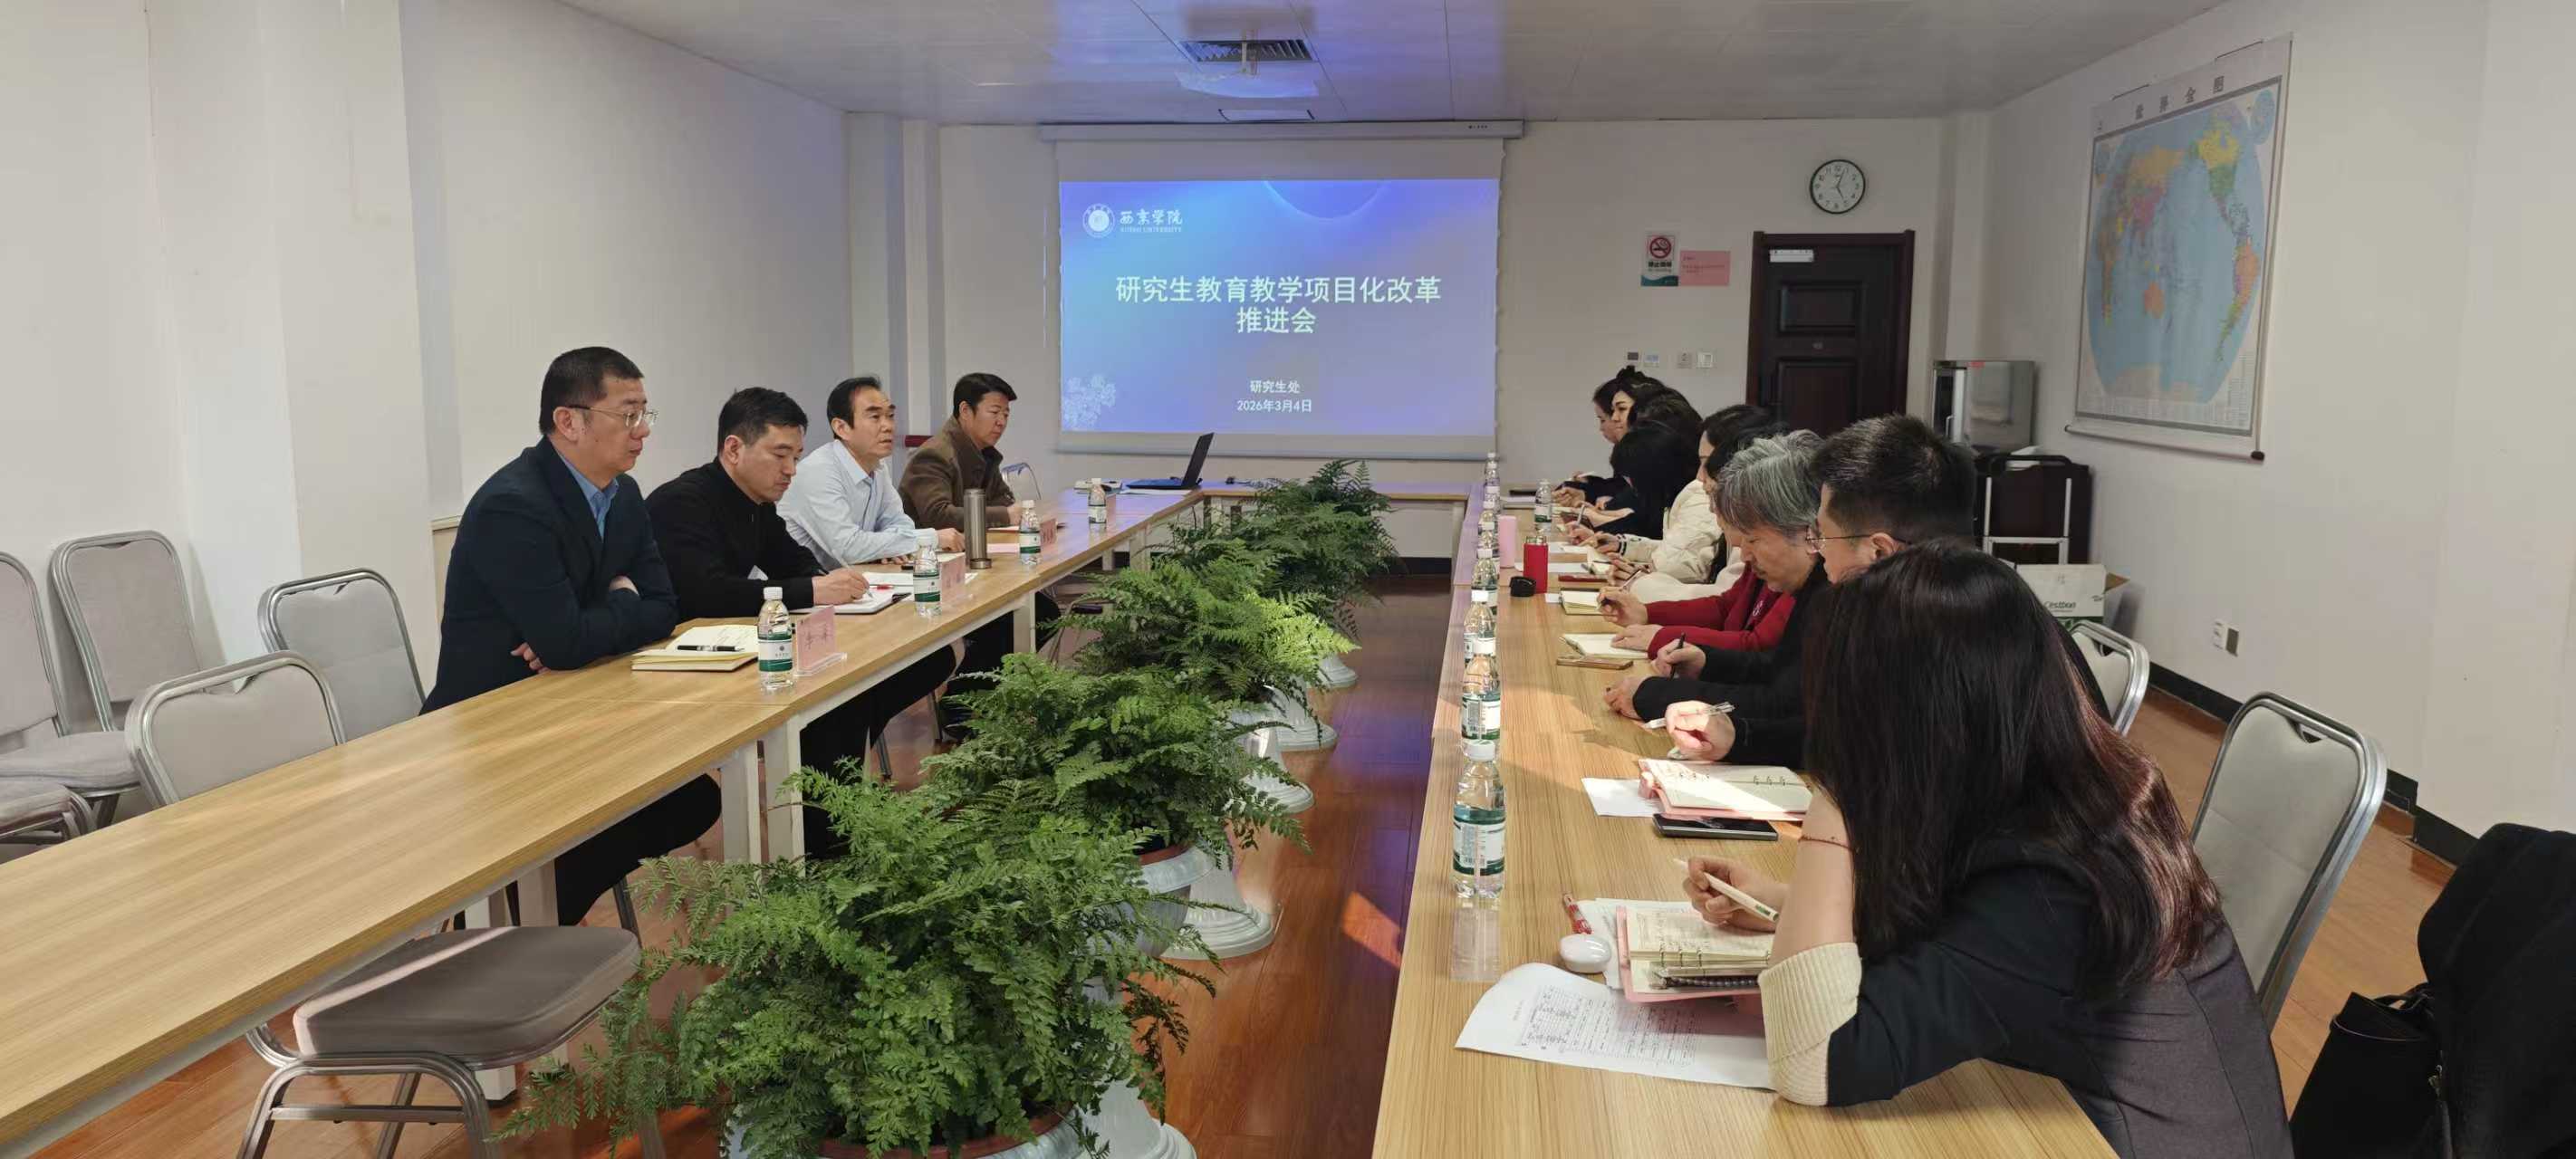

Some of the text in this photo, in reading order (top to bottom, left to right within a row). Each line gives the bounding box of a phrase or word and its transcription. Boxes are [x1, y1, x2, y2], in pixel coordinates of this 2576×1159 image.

[1120, 207, 1183, 225] 西京学院
[1115, 275, 1442, 303] 研究生教育教学项目化改革
[1236, 306, 1317, 334] 推进会
[1249, 378, 1302, 394] 研究生处
[1236, 398, 1312, 413] 2026年3月4日
